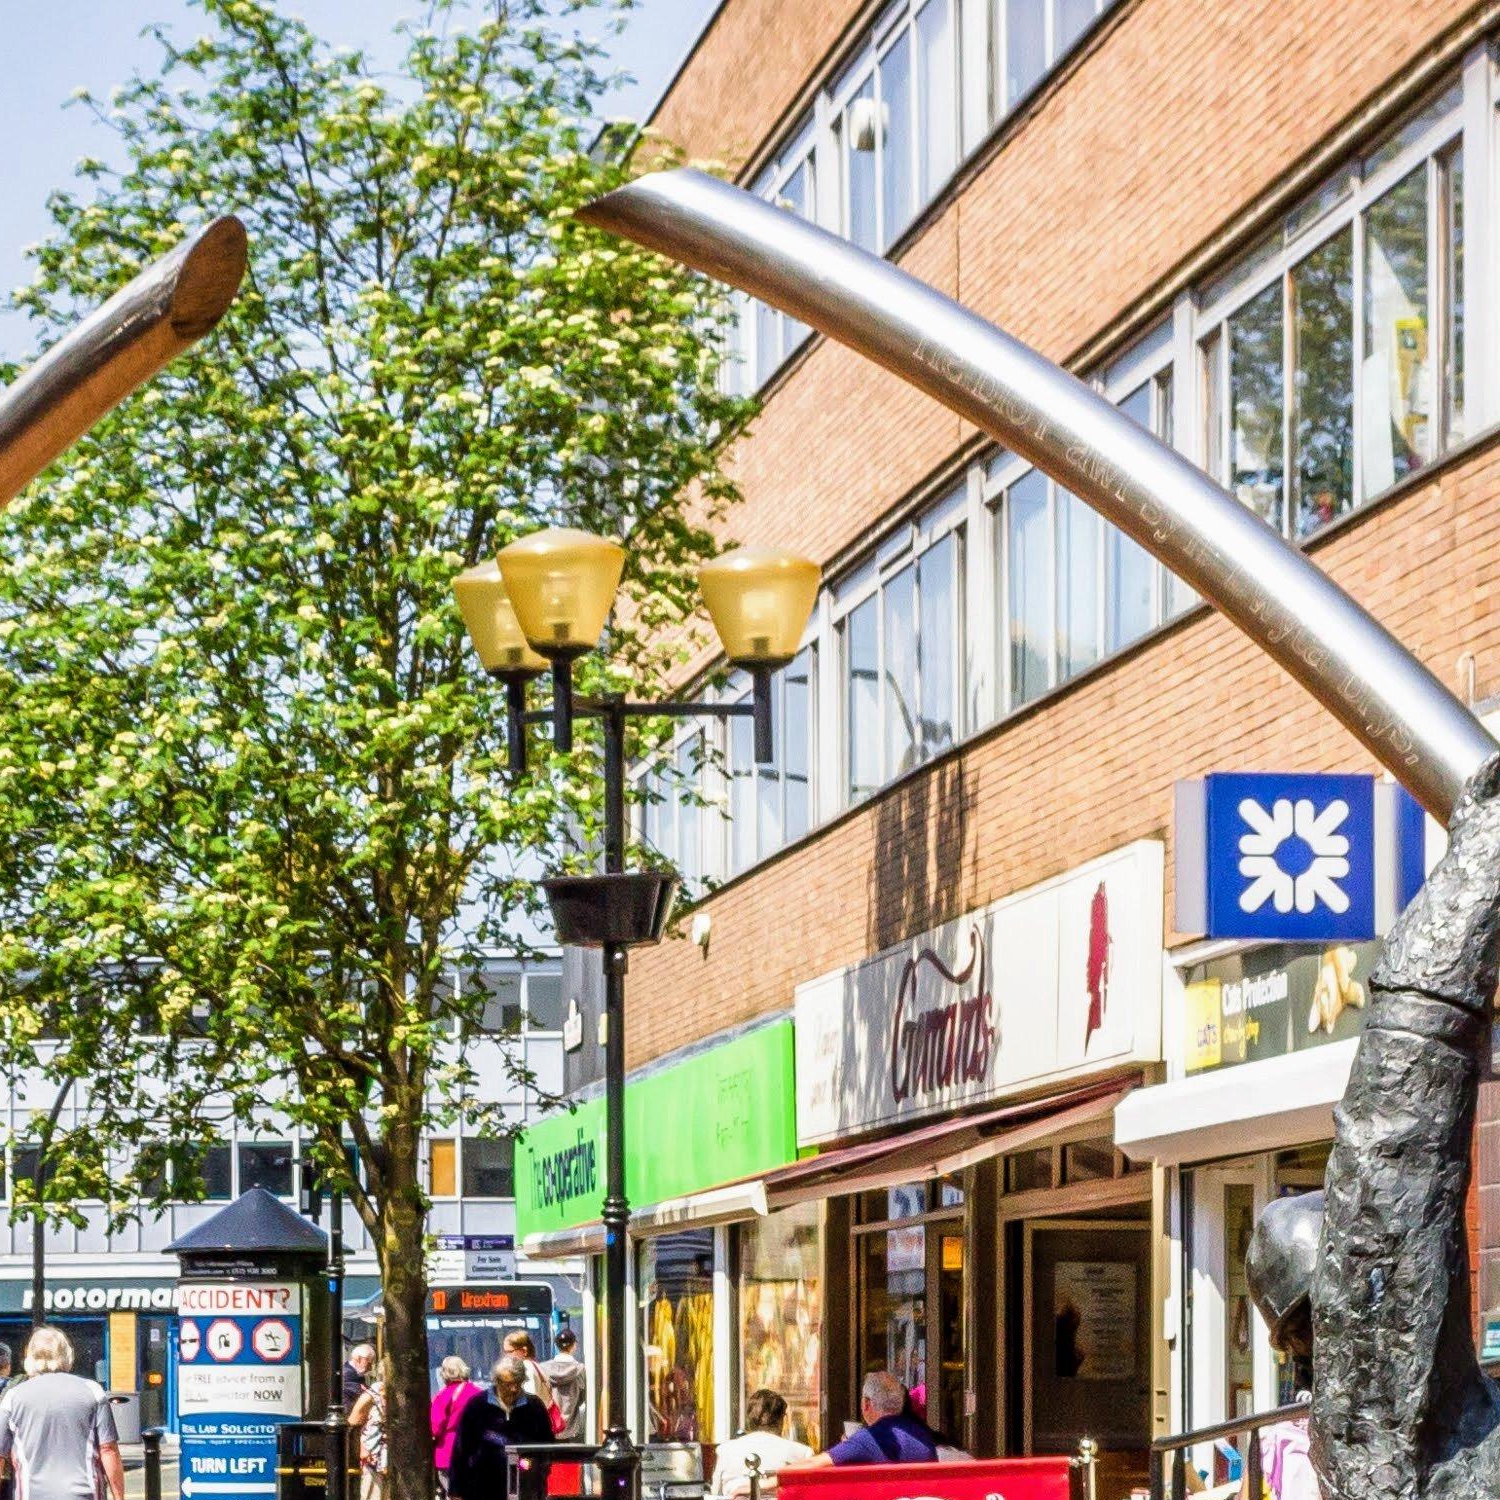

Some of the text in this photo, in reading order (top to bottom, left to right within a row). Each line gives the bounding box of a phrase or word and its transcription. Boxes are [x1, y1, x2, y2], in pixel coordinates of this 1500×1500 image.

[543, 1127, 596, 1218] co-operative
[22, 1286, 180, 1310] motorma
[182, 1287, 291, 1310] ACCIDENT?
[249, 1373, 276, 1384] from
[278, 1375, 285, 1384] a
[253, 1389, 283, 1401] NOW
[220, 1423, 276, 1434] SOLICITO
[190, 1457, 267, 1474] TURN LEFT
